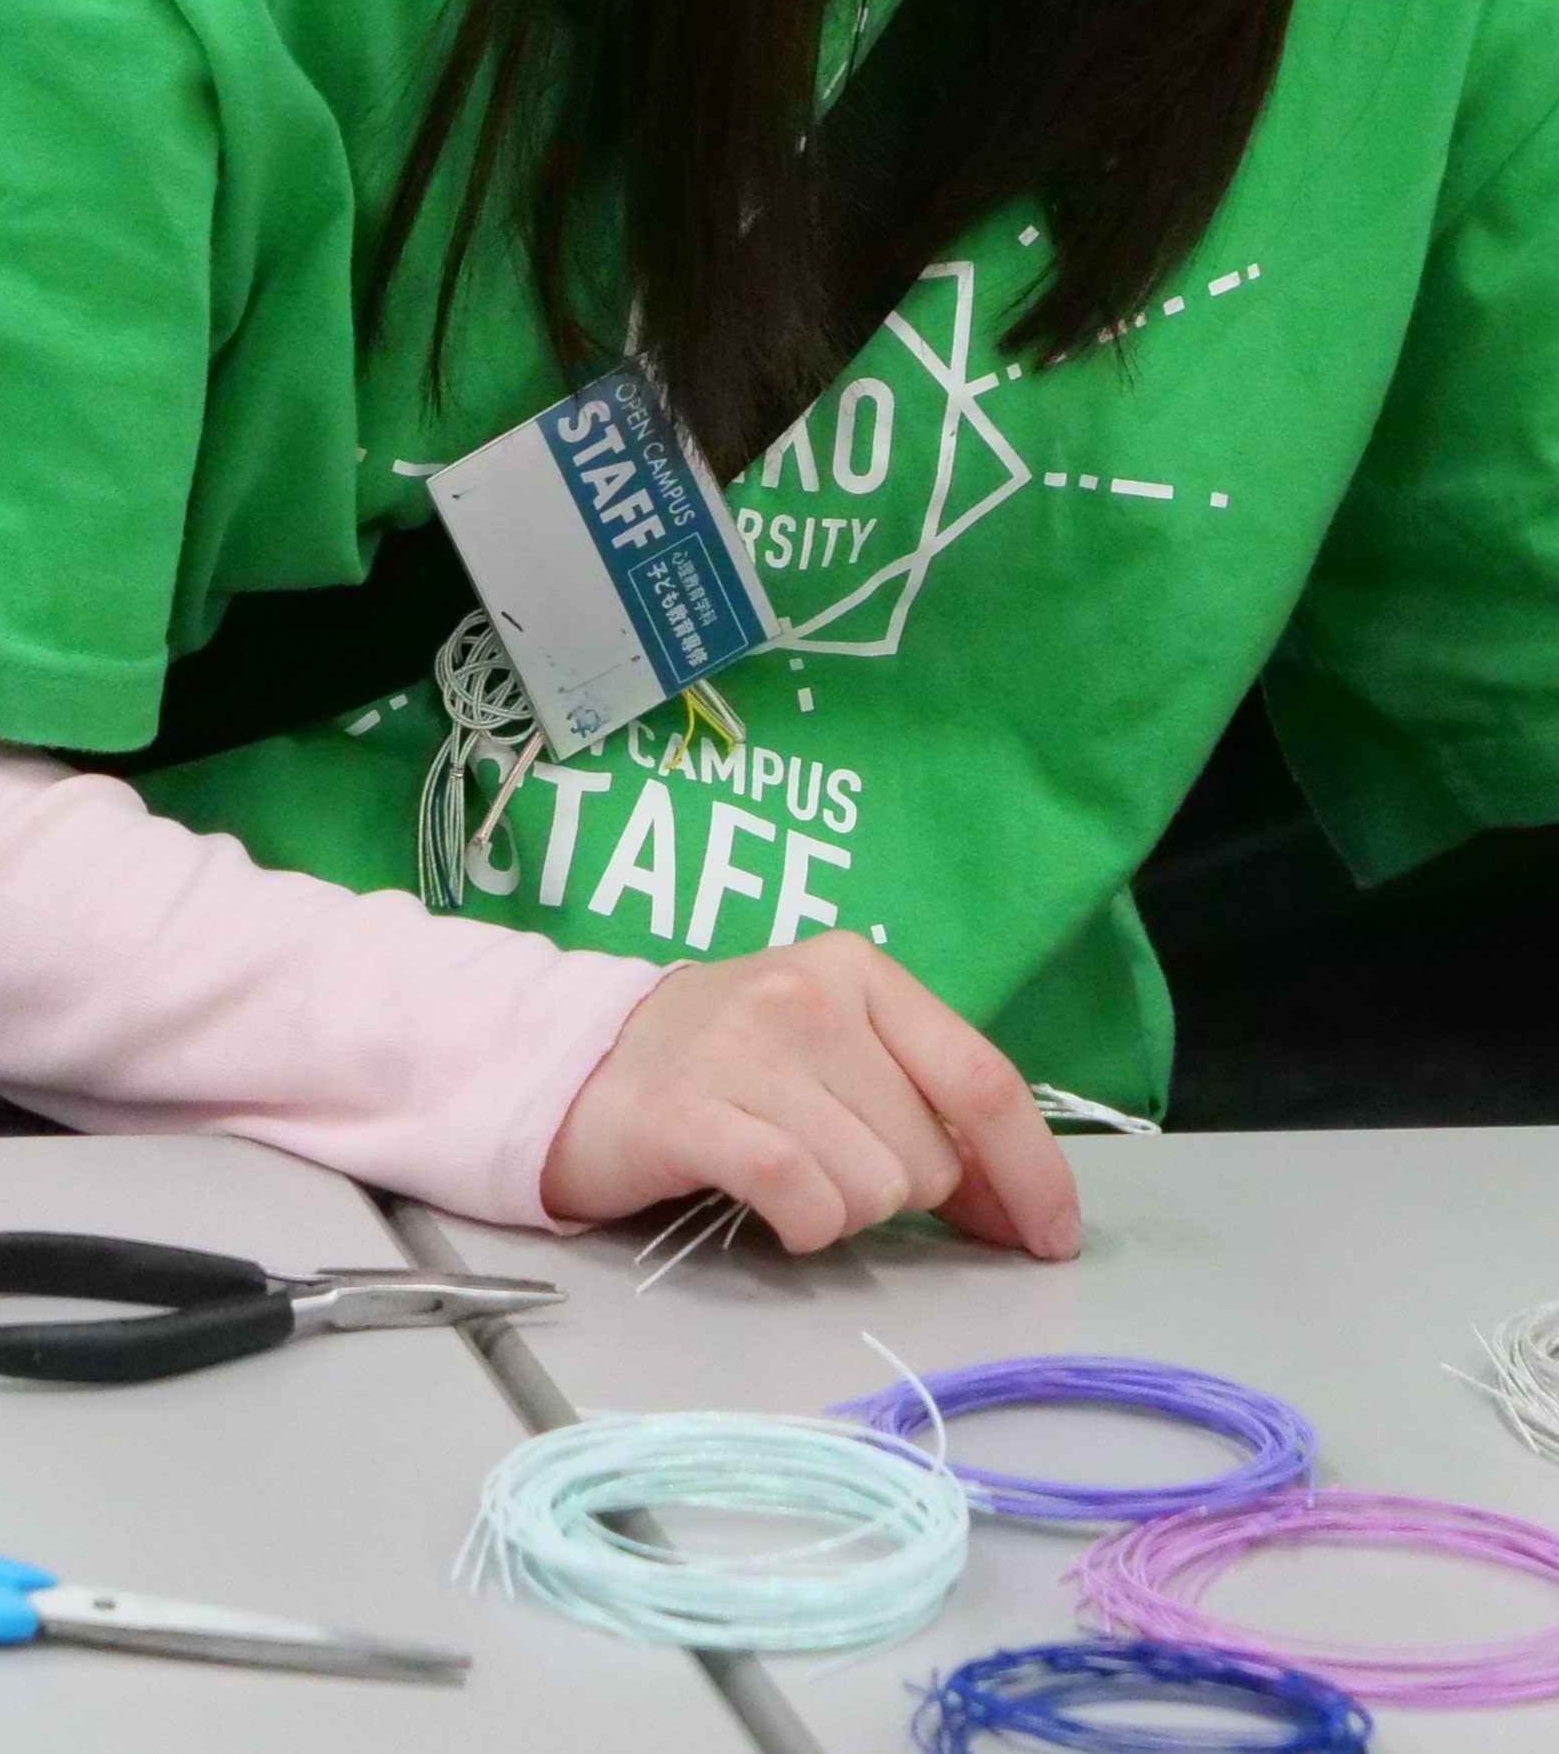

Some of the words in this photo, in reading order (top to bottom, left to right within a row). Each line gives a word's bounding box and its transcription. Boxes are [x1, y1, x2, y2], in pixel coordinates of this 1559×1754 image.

[558, 400, 667, 550] STAFF
[615, 383, 652, 441] OPEN
[643, 442, 696, 526] CAMPUS
[732, 377, 895, 495] KO
[672, 550, 719, 627] 心理教育学科
[737, 507, 878, 571] RSITY
[647, 561, 709, 667] 子ども教育専修
[628, 719, 863, 834] CAMPUS
